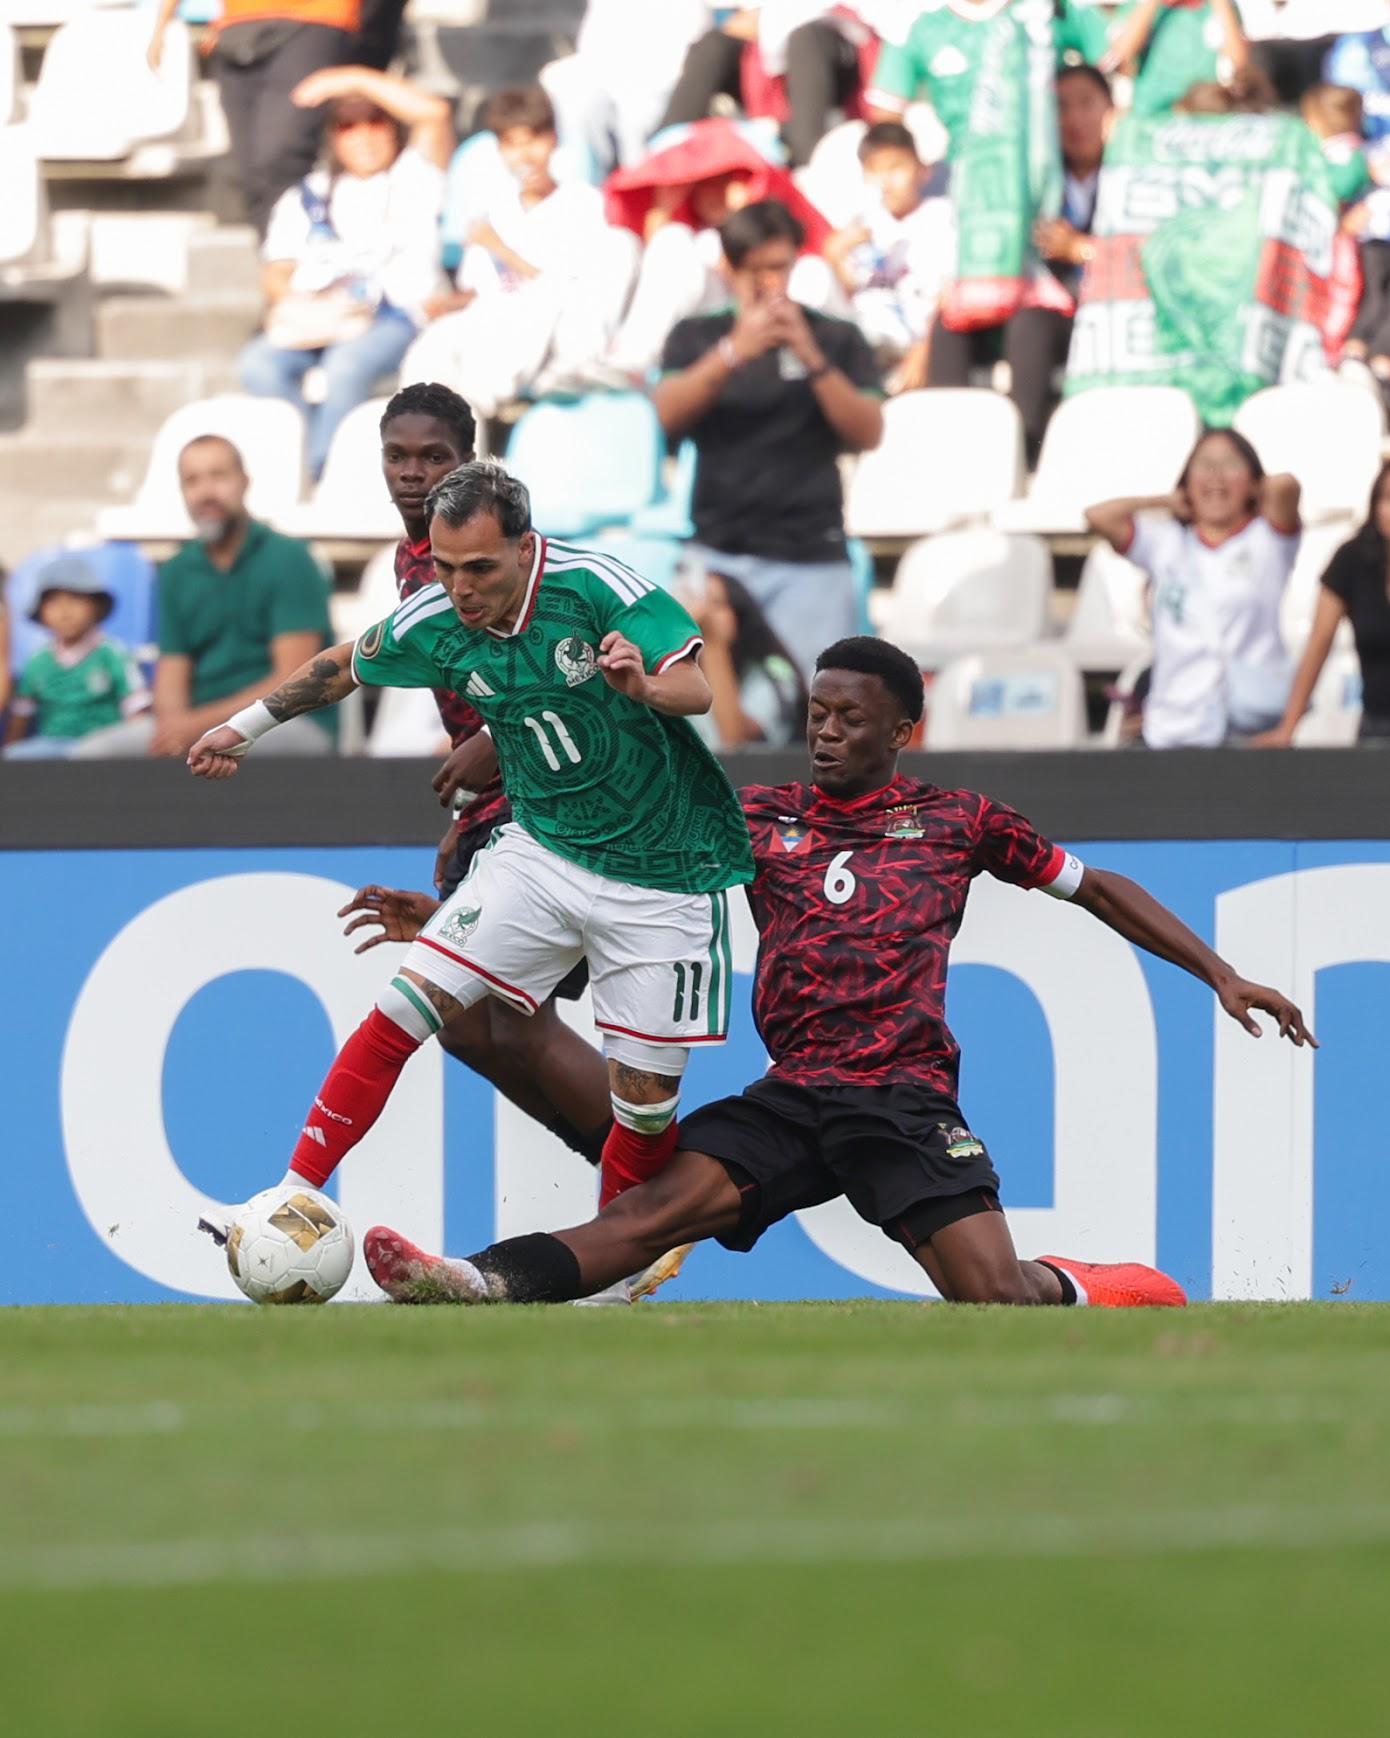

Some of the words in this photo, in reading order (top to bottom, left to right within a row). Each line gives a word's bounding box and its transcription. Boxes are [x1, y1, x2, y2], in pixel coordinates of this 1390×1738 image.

[524, 710, 582, 772] 11
[823, 850, 856, 905] 6
[672, 961, 703, 1023] 11
